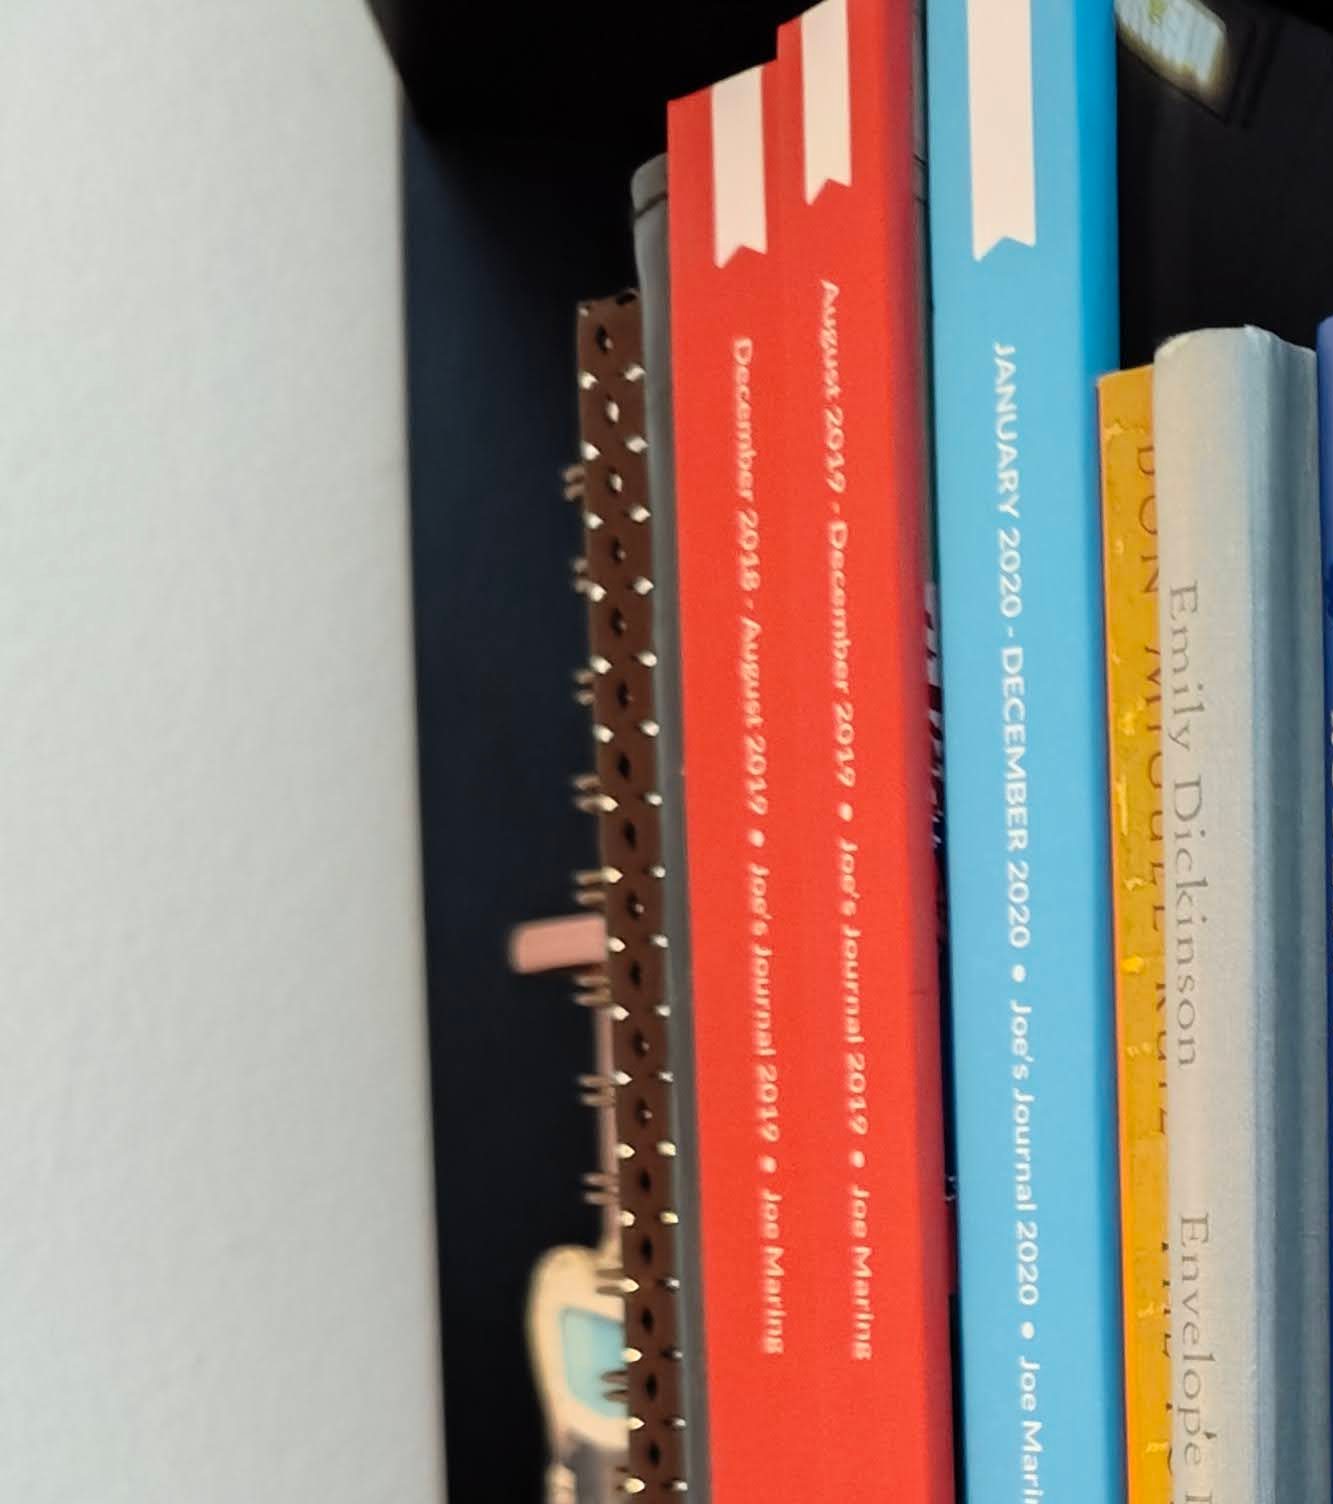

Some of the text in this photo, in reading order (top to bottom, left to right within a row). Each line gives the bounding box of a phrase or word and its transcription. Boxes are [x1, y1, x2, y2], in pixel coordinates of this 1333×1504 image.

[820, 280, 841, 400] August
[734, 338, 756, 501] December
[825, 407, 845, 492] 2019
[995, 343, 1019, 517] JANUARY
[739, 510, 759, 590] 2018
[999, 528, 1022, 617] 2020
[829, 521, 852, 698] December
[741, 617, 763, 727] August
[745, 736, 767, 814] 2019
[834, 703, 855, 786] 2019
[1002, 647, 1027, 851] DECEMBER
[1168, 581, 1208, 1065] Emily Dickinson
[749, 864, 771, 935] Joe's
[839, 839, 859, 915] Joe's
[1008, 862, 1030, 948] 2020
[752, 945, 776, 1055] Journal
[843, 925, 864, 1043] Journal
[1011, 1000, 1033, 1079] Joe's
[757, 1065, 778, 1141] 2019
[847, 1054, 867, 1134] 2019
[1014, 1089, 1036, 1210] Journal
[762, 1190, 781, 1239] Joe
[851, 1186, 869, 1237] Joe
[763, 1246, 785, 1353] Maring
[853, 1246, 873, 1359] Maring
[1017, 1222, 1038, 1305] 2020
[1177, 1213, 1215, 1466] Envelope
[1020, 1356, 1040, 1411] Joe
